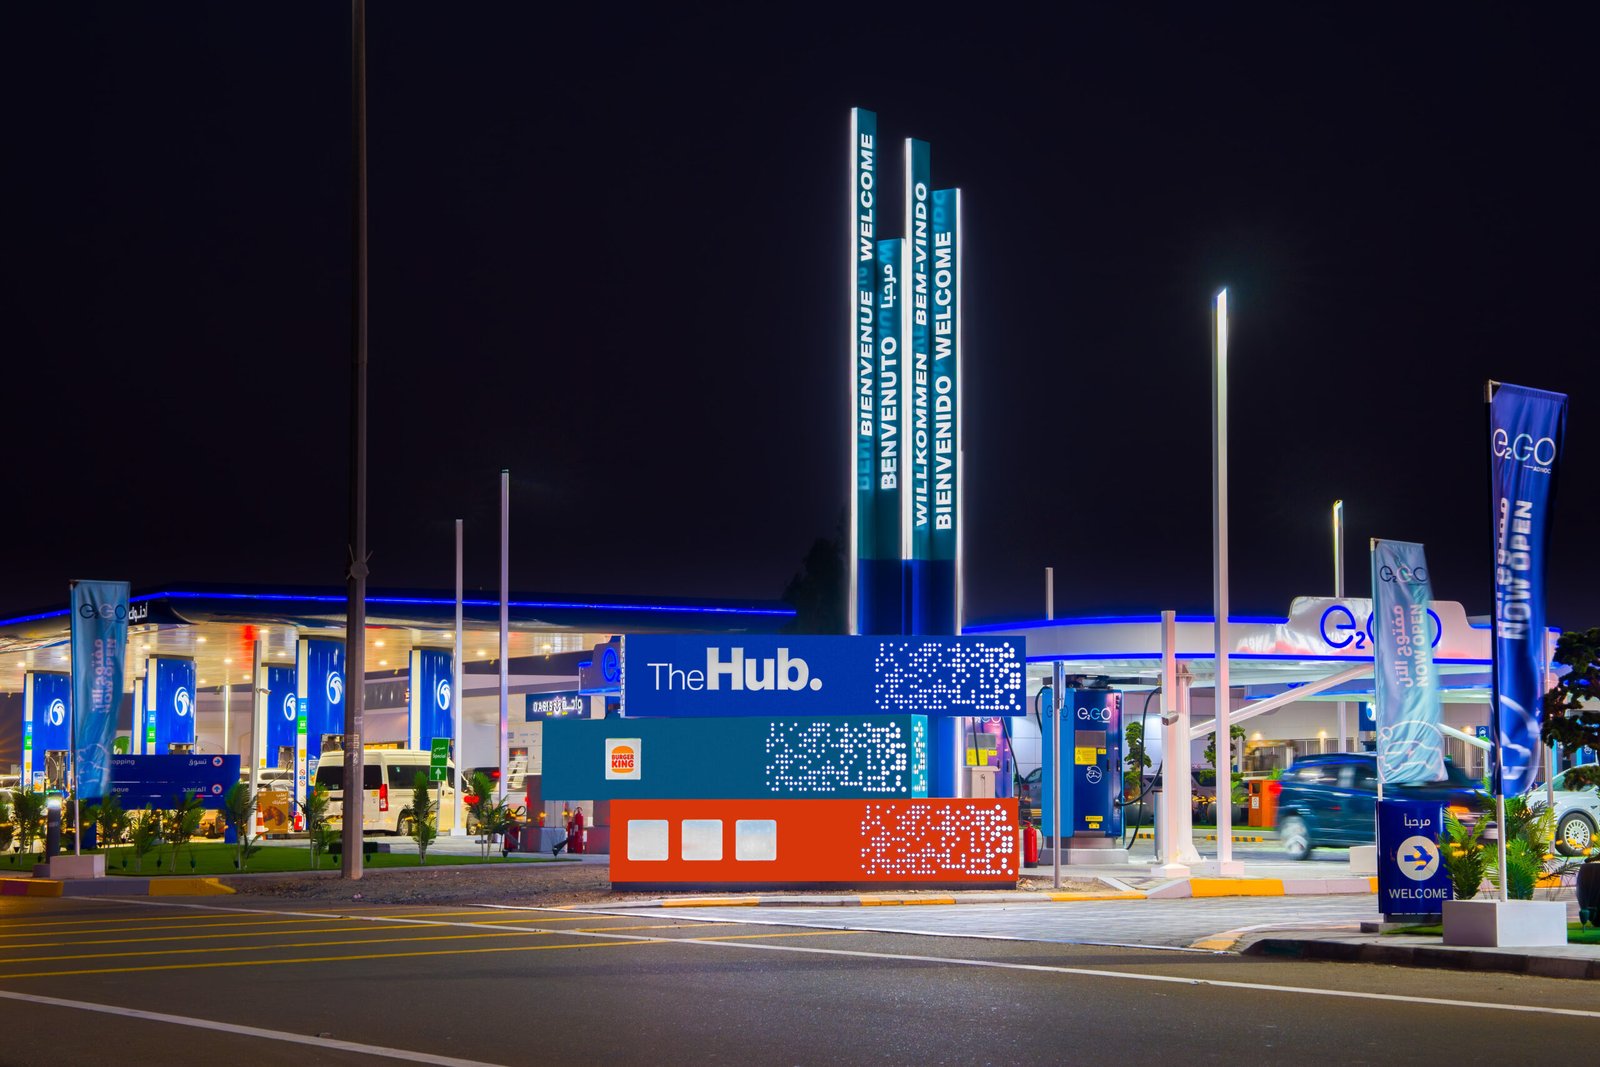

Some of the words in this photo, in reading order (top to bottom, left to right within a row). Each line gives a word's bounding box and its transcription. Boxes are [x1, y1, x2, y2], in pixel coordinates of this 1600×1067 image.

[861, 133, 873, 261] WELCOME
[915, 182, 927, 326] BEM-VINDO
[935, 231, 951, 360] WELCOME
[861, 290, 873, 437] BIENVENUE
[881, 336, 897, 490] BENVENUTO
[916, 353, 927, 526] WILLKOMMEN
[935, 375, 952, 530] BIENVENIDO
[1510, 500, 1533, 571] OPEN
[1410, 604, 1425, 646] OPEN
[1414, 650, 1429, 687] NOW
[1499, 578, 1532, 640] NOW
[611, 760, 634, 768] KING
[1388, 888, 1448, 899] WELCOME
